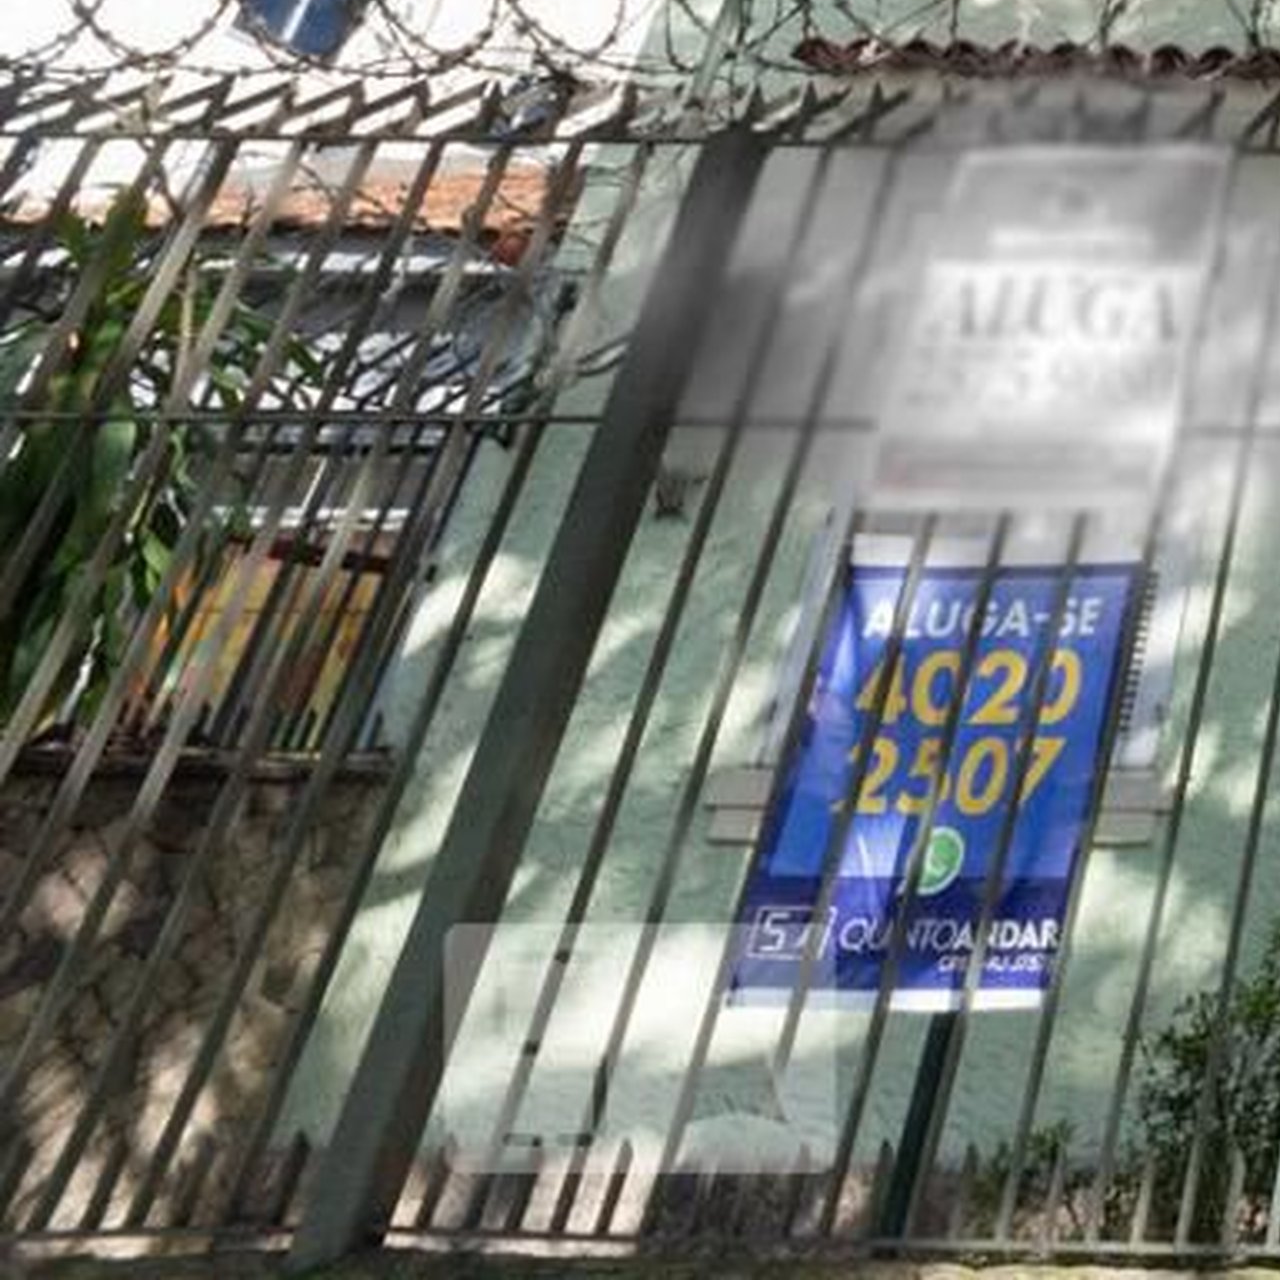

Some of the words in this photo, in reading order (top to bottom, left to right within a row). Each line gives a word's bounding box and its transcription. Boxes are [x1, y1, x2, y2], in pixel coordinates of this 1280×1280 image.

[854, 648, 1082, 726] 4020
[831, 736, 1068, 816] 2507
[838, 917, 1061, 952] QUNTOANDAR
